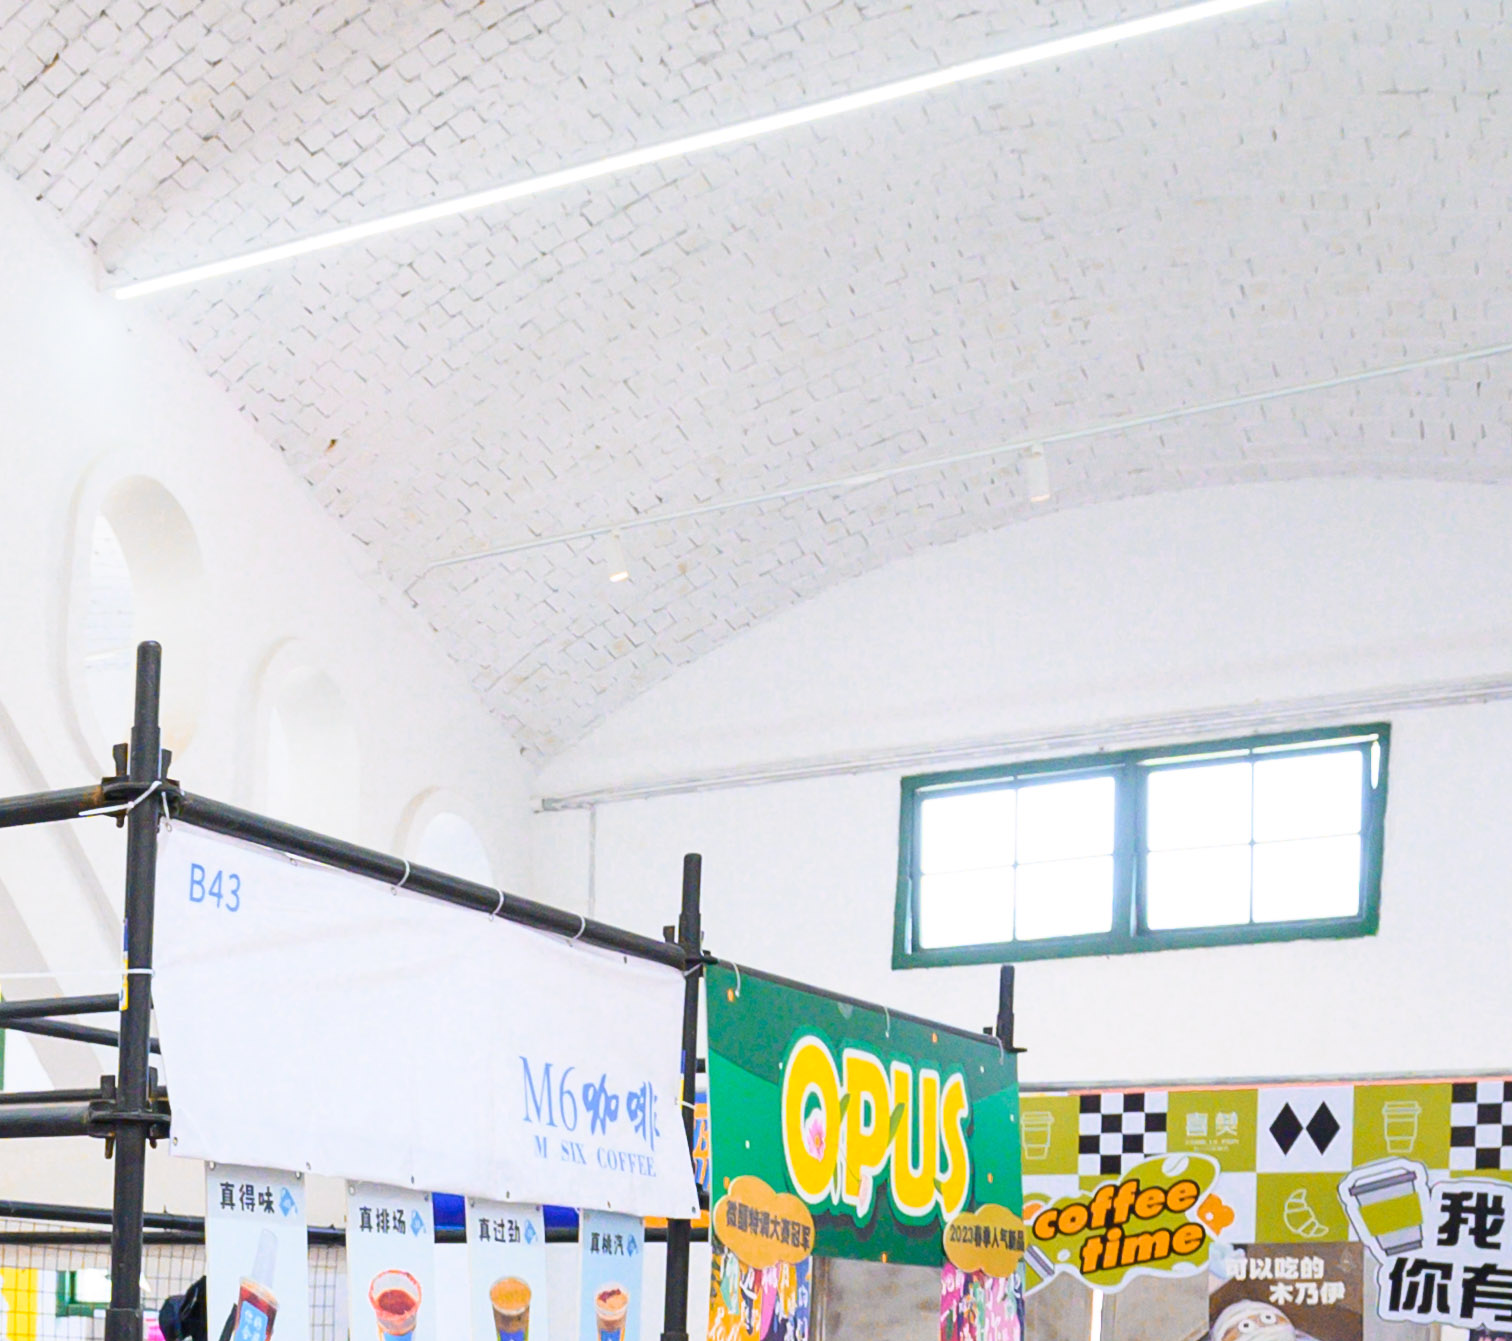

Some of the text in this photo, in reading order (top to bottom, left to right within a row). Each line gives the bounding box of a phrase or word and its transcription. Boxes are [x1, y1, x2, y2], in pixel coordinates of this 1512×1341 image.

[189, 863, 243, 913] B43
[781, 1034, 971, 1218] OPUS
[534, 1135, 658, 1178] M SIX COFFEE
[220, 1182, 275, 1214] 真得味
[1032, 1178, 1201, 1241] coffee
[359, 1206, 406, 1236] 真排场
[1079, 1222, 1206, 1275] time
[1225, 1255, 1325, 1282] 可以吃的
[1269, 1280, 1346, 1306] 木乃伊
